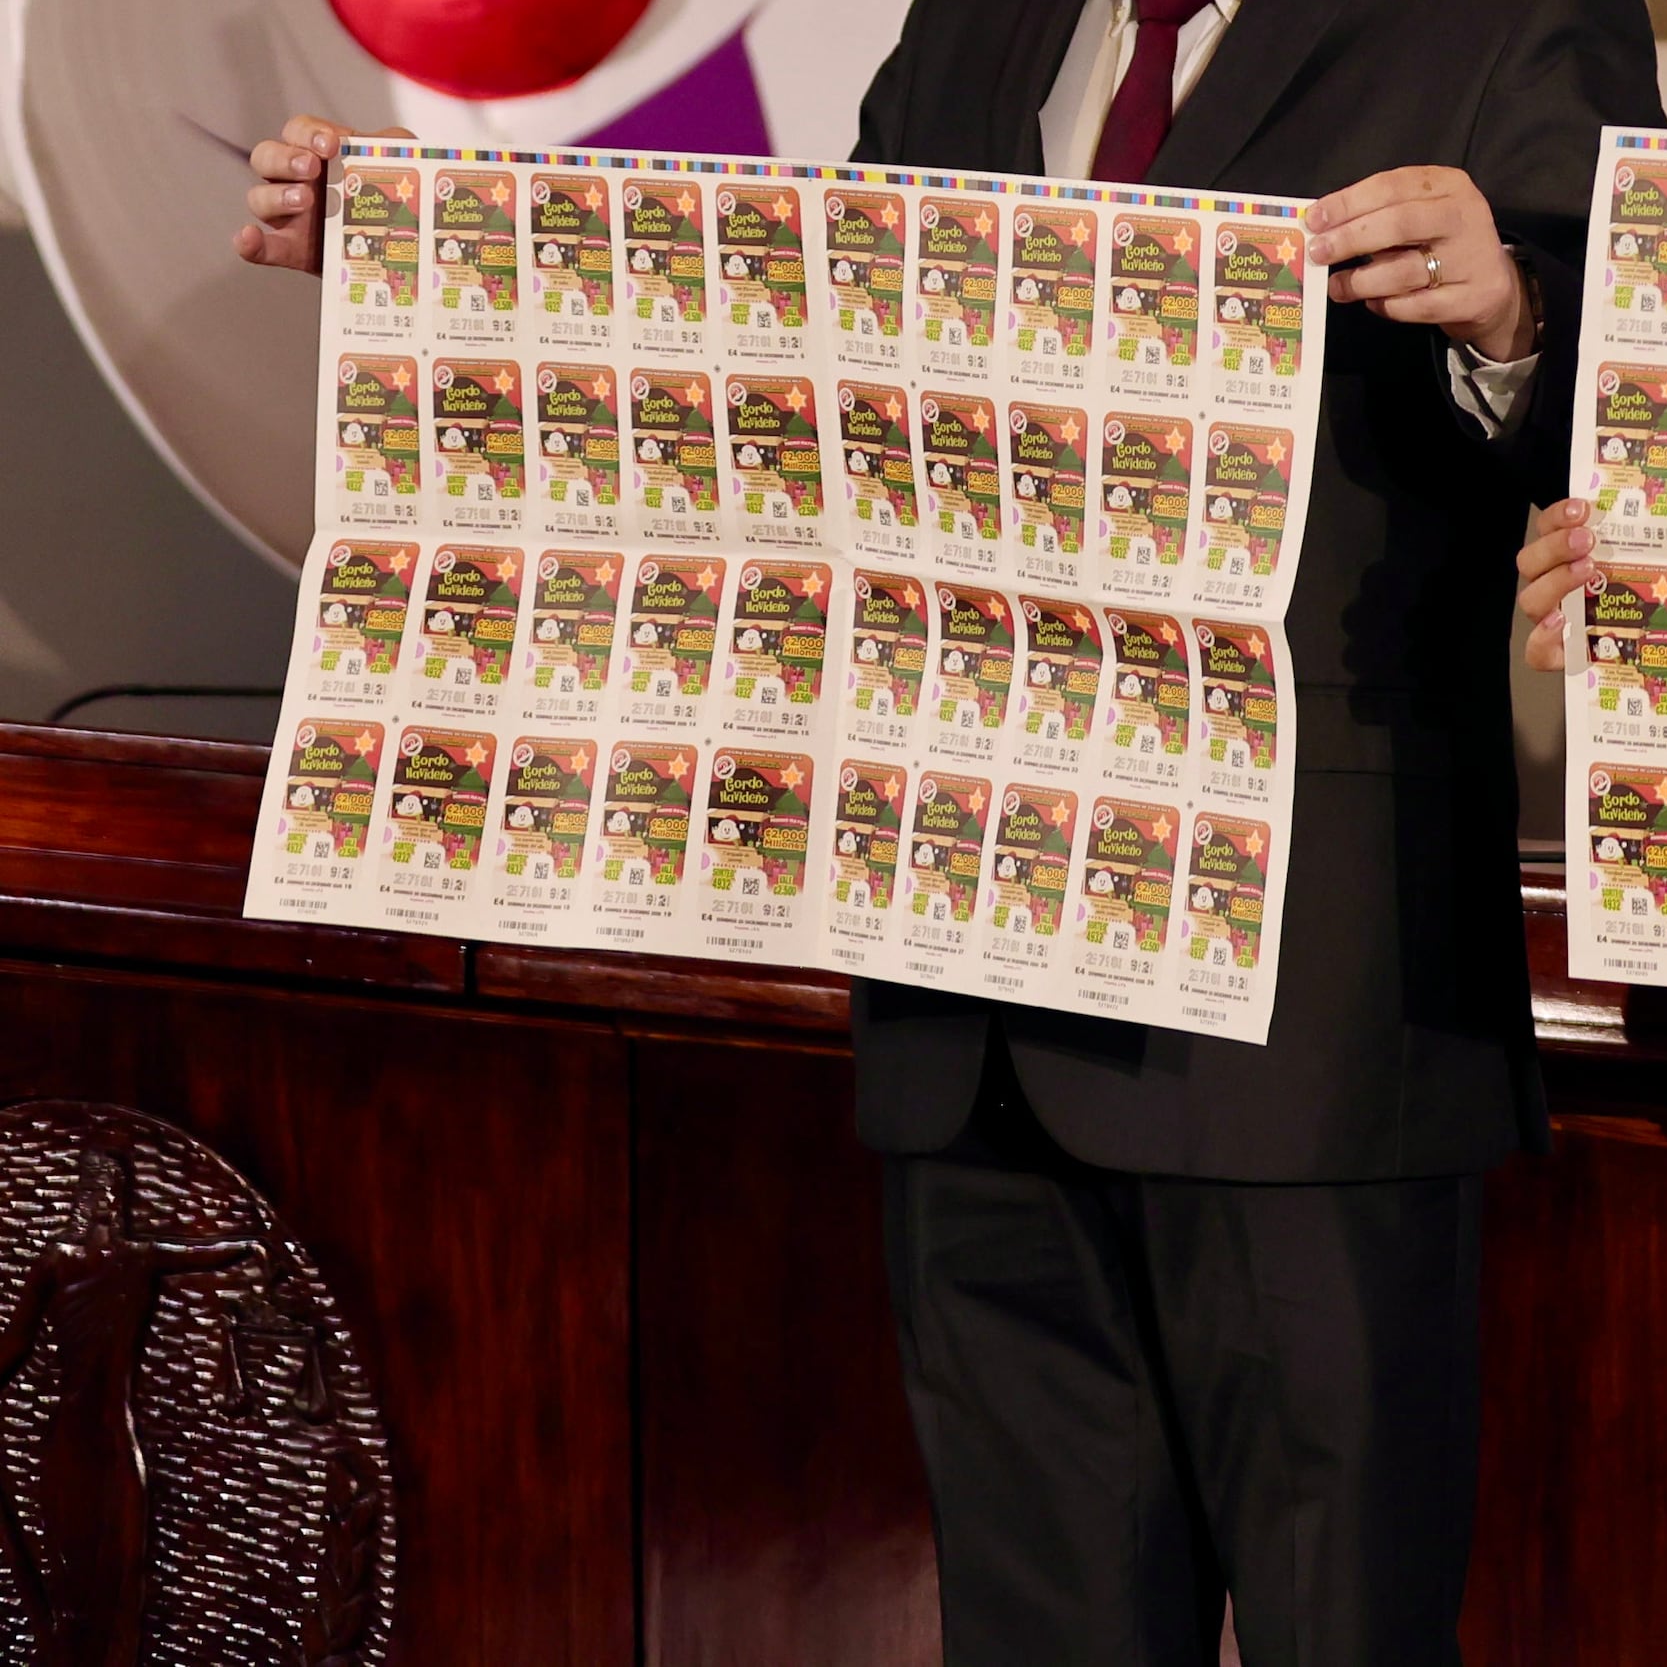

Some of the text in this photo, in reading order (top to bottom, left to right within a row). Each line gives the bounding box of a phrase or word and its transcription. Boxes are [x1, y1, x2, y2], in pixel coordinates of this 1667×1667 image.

[635, 205, 665, 224] Gordo
[931, 225, 961, 243] Gordo
[446, 383, 480, 402] Gordo
[1117, 441, 1150, 459] Gordo
[338, 562, 372, 579] Gordo
[750, 585, 786, 603] Gordo
[1599, 590, 1636, 609] Gordo
[411, 753, 448, 770] Gordo
[620, 767, 654, 786] Gordo
[725, 776, 764, 793] Gordo
[1603, 791, 1640, 810] Gordo
